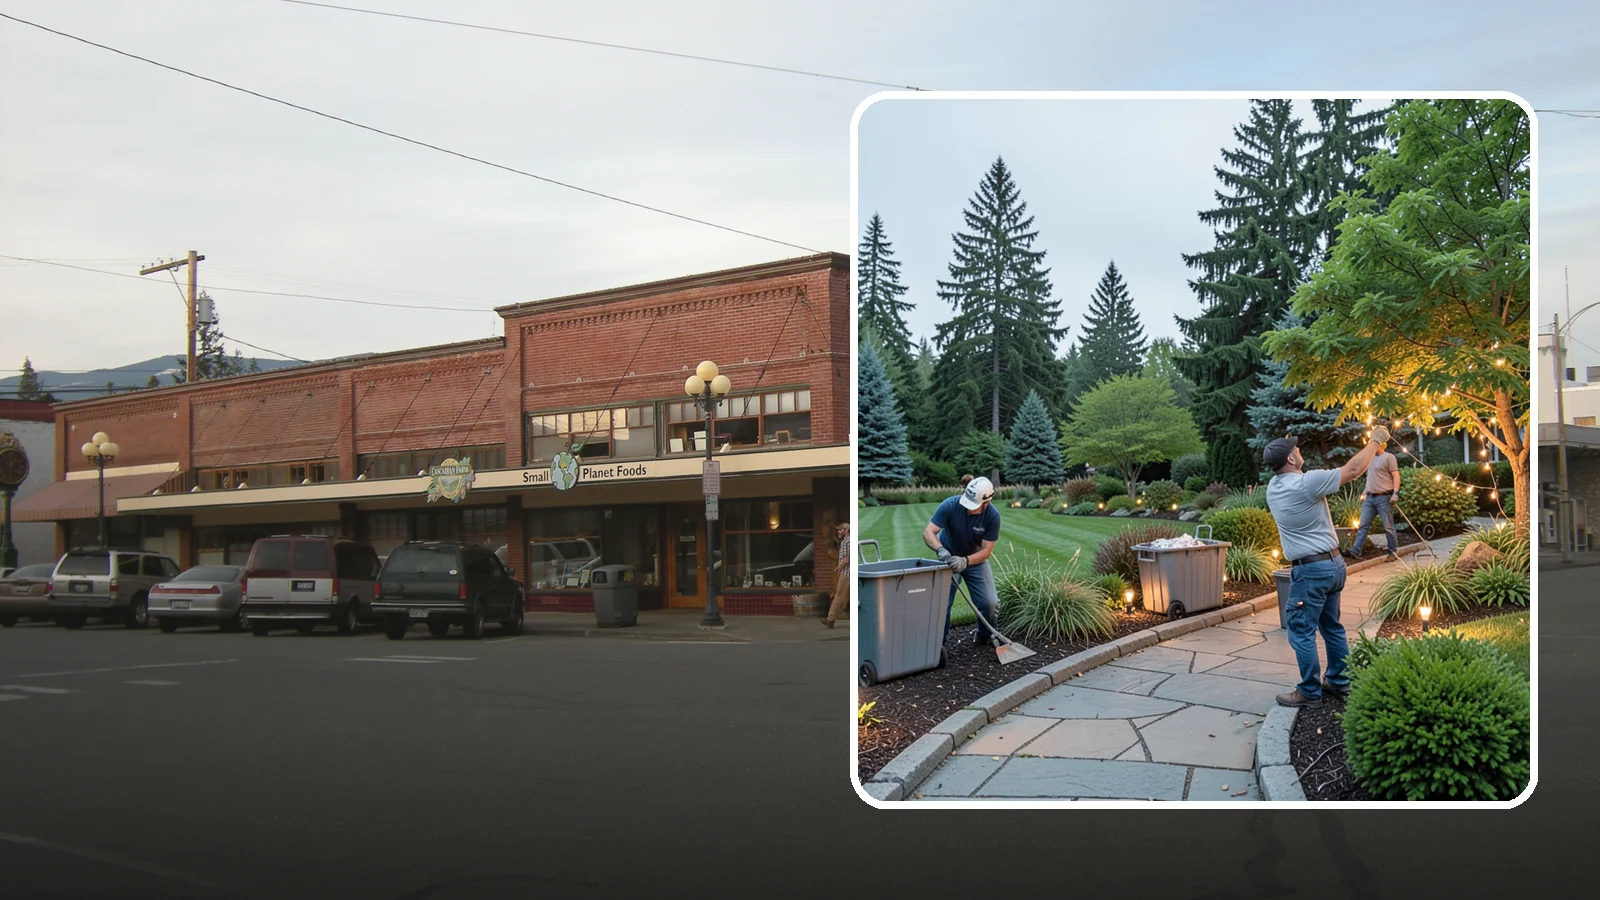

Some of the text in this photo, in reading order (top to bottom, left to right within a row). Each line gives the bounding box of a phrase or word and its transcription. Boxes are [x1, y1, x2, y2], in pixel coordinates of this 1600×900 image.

[523, 464, 647, 483] Small Planet Foods
